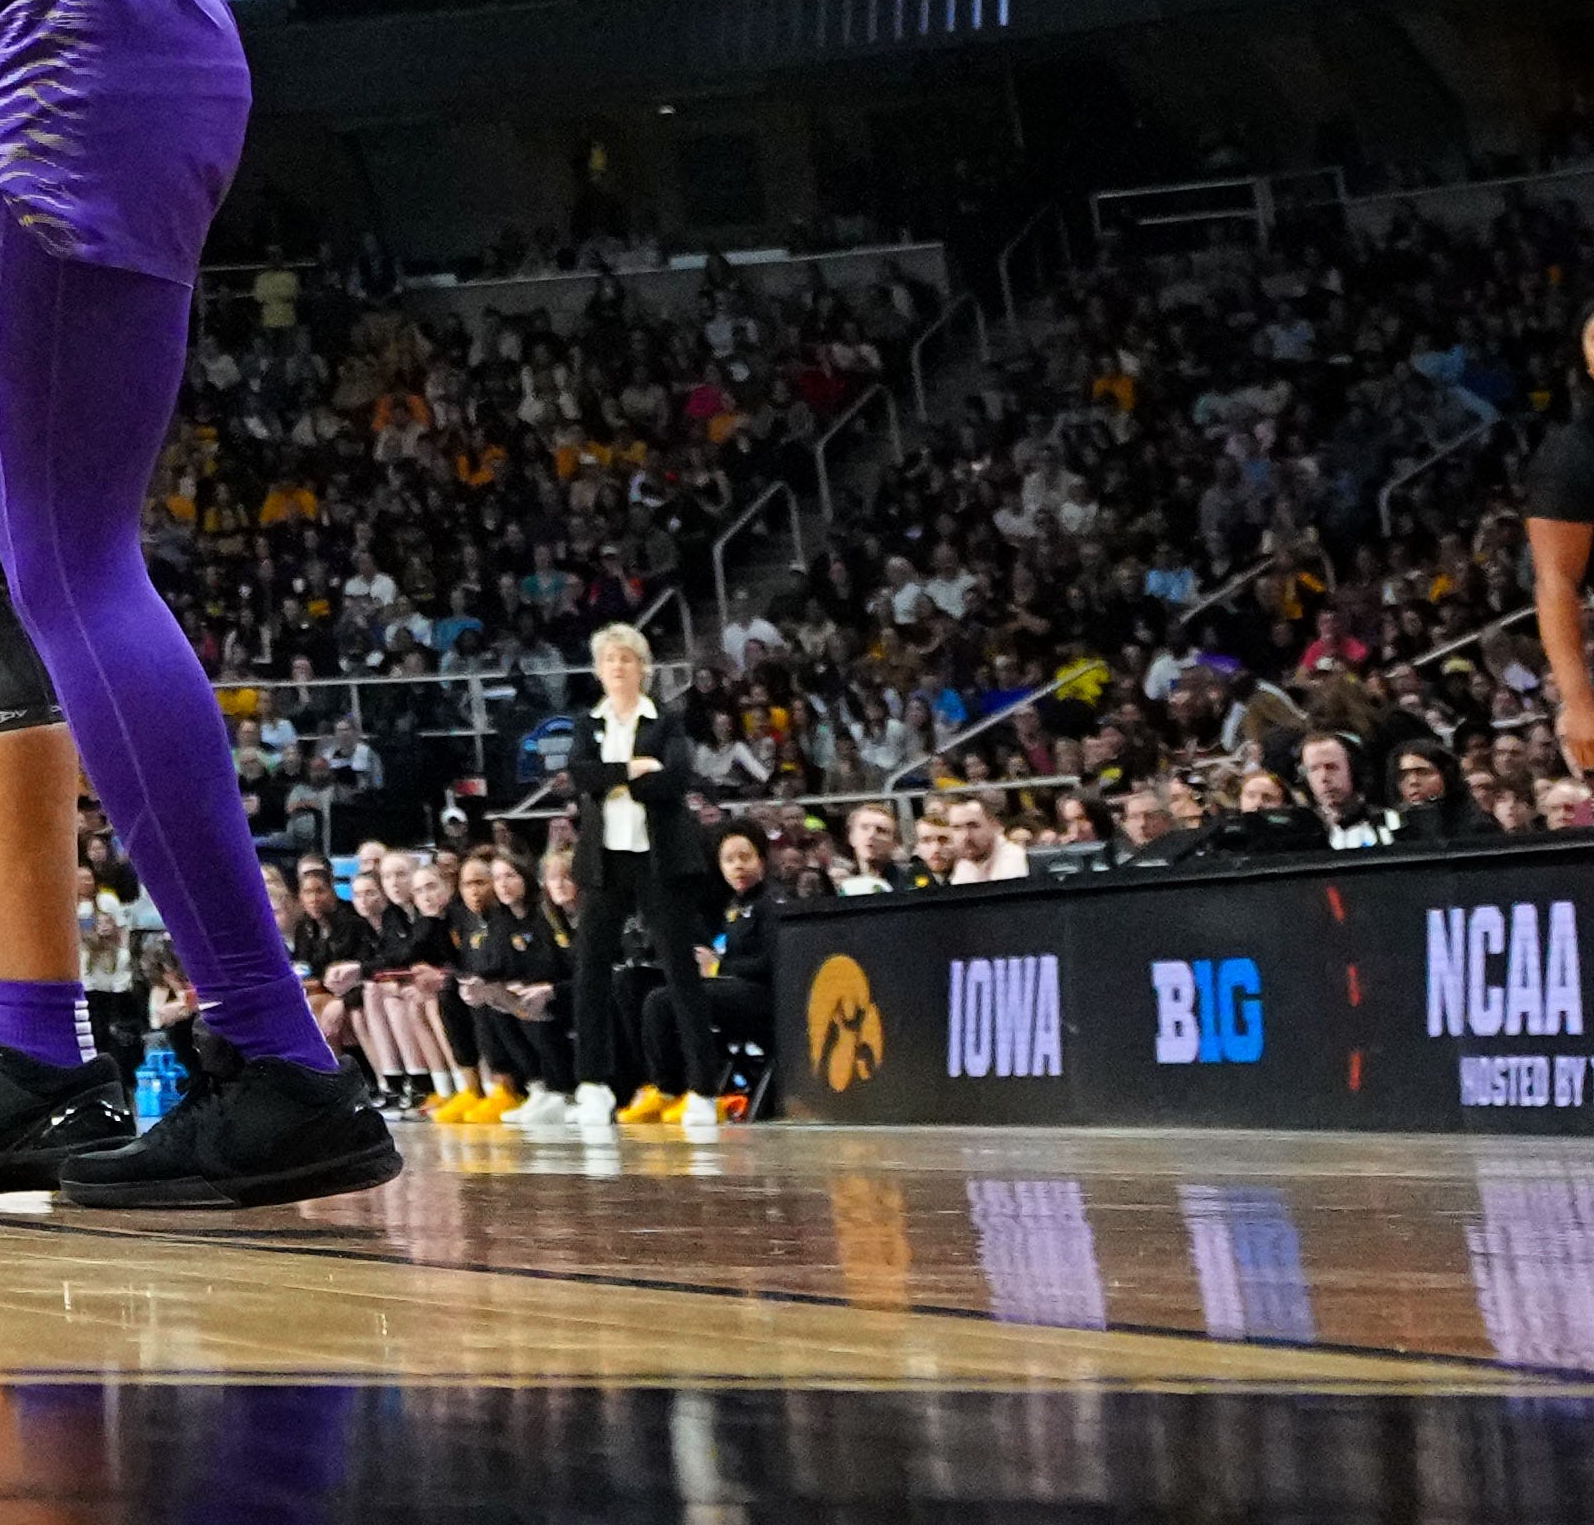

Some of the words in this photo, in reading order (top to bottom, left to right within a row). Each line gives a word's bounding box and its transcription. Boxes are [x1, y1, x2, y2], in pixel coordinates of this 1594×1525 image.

[947, 953, 1063, 1080] IOWA
[1425, 899, 1584, 1038] NCAA
[1459, 1054, 1551, 1107] HOSTED
[1553, 1054, 1588, 1107] BY
